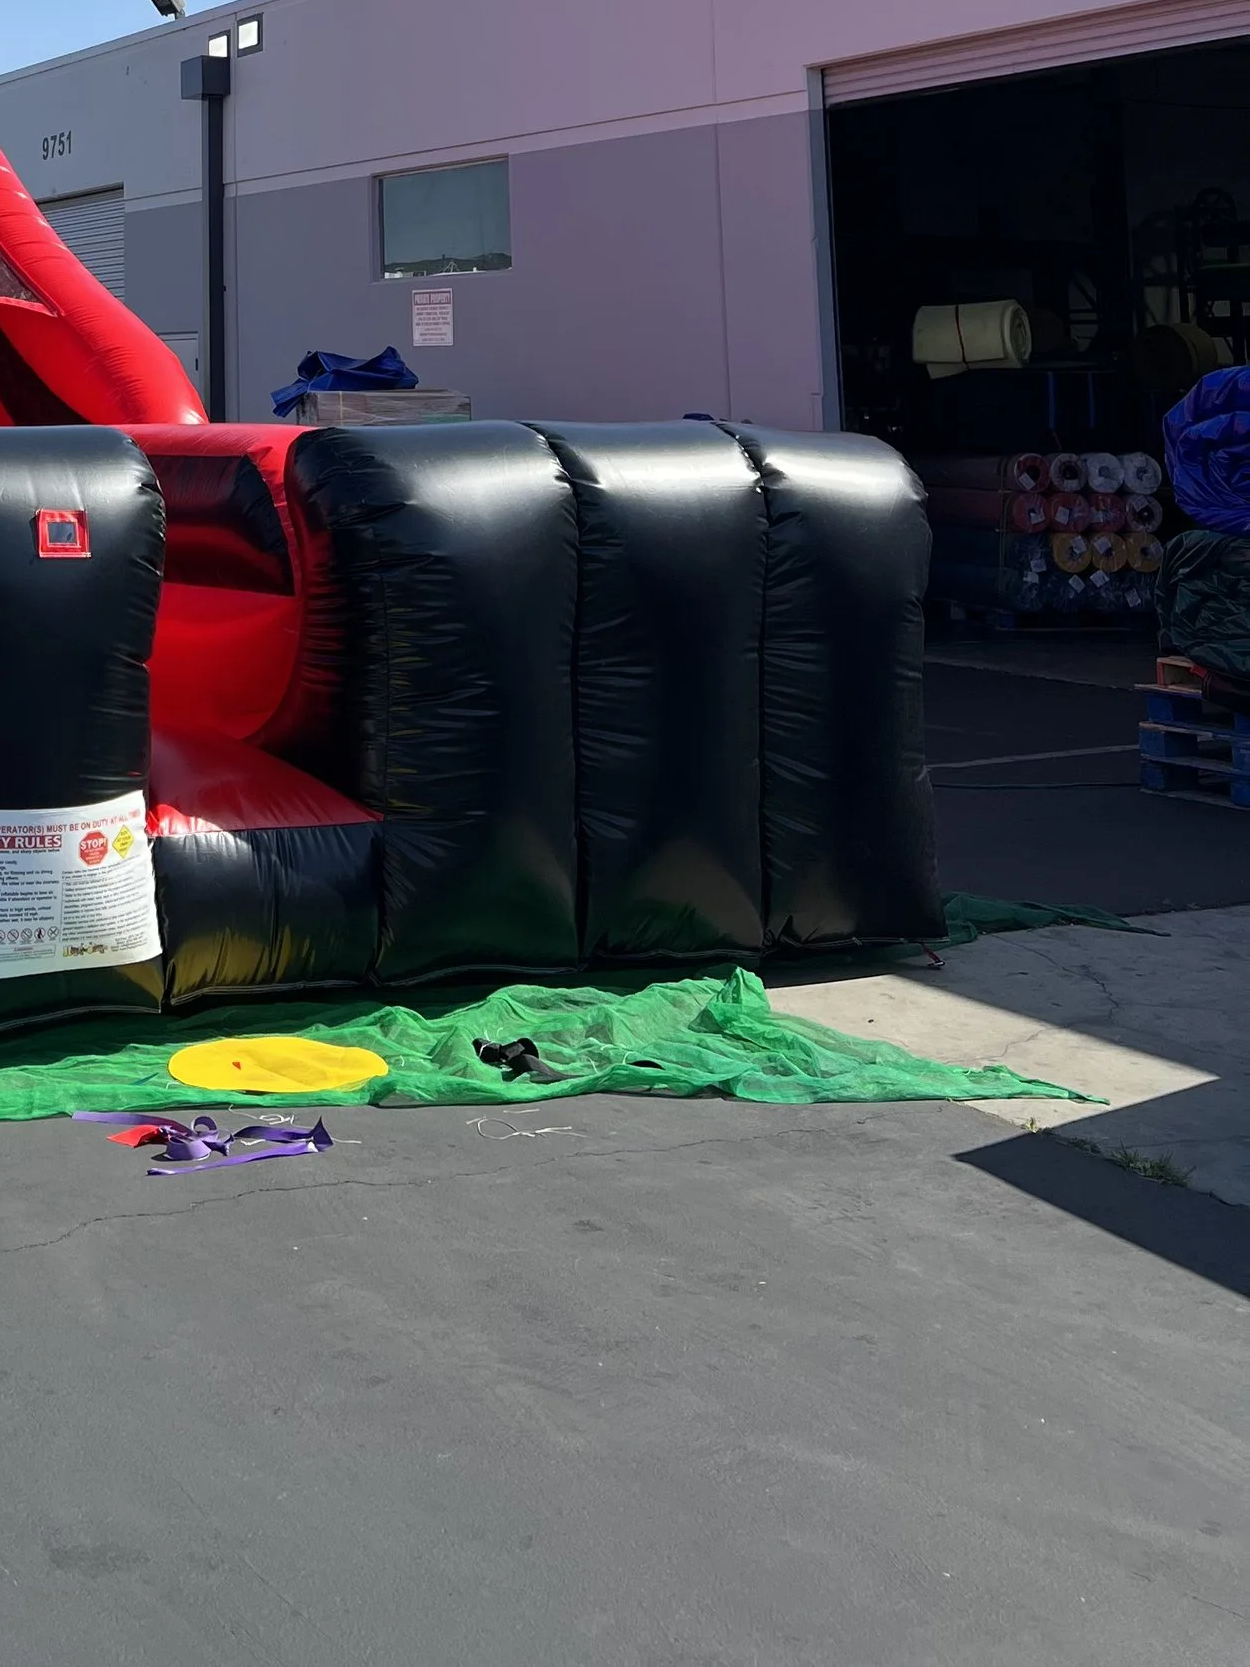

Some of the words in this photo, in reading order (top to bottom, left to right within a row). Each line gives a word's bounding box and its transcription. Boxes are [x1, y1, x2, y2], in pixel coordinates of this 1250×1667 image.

[42, 130, 72, 160] 9751
[47, 824, 67, 833] MUST
[69, 823, 79, 832] BE
[80, 821, 91, 831] ON
[93, 818, 108, 828] DUTY
[15, 835, 61, 848] RULES
[80, 838, 106, 850] STOP!
